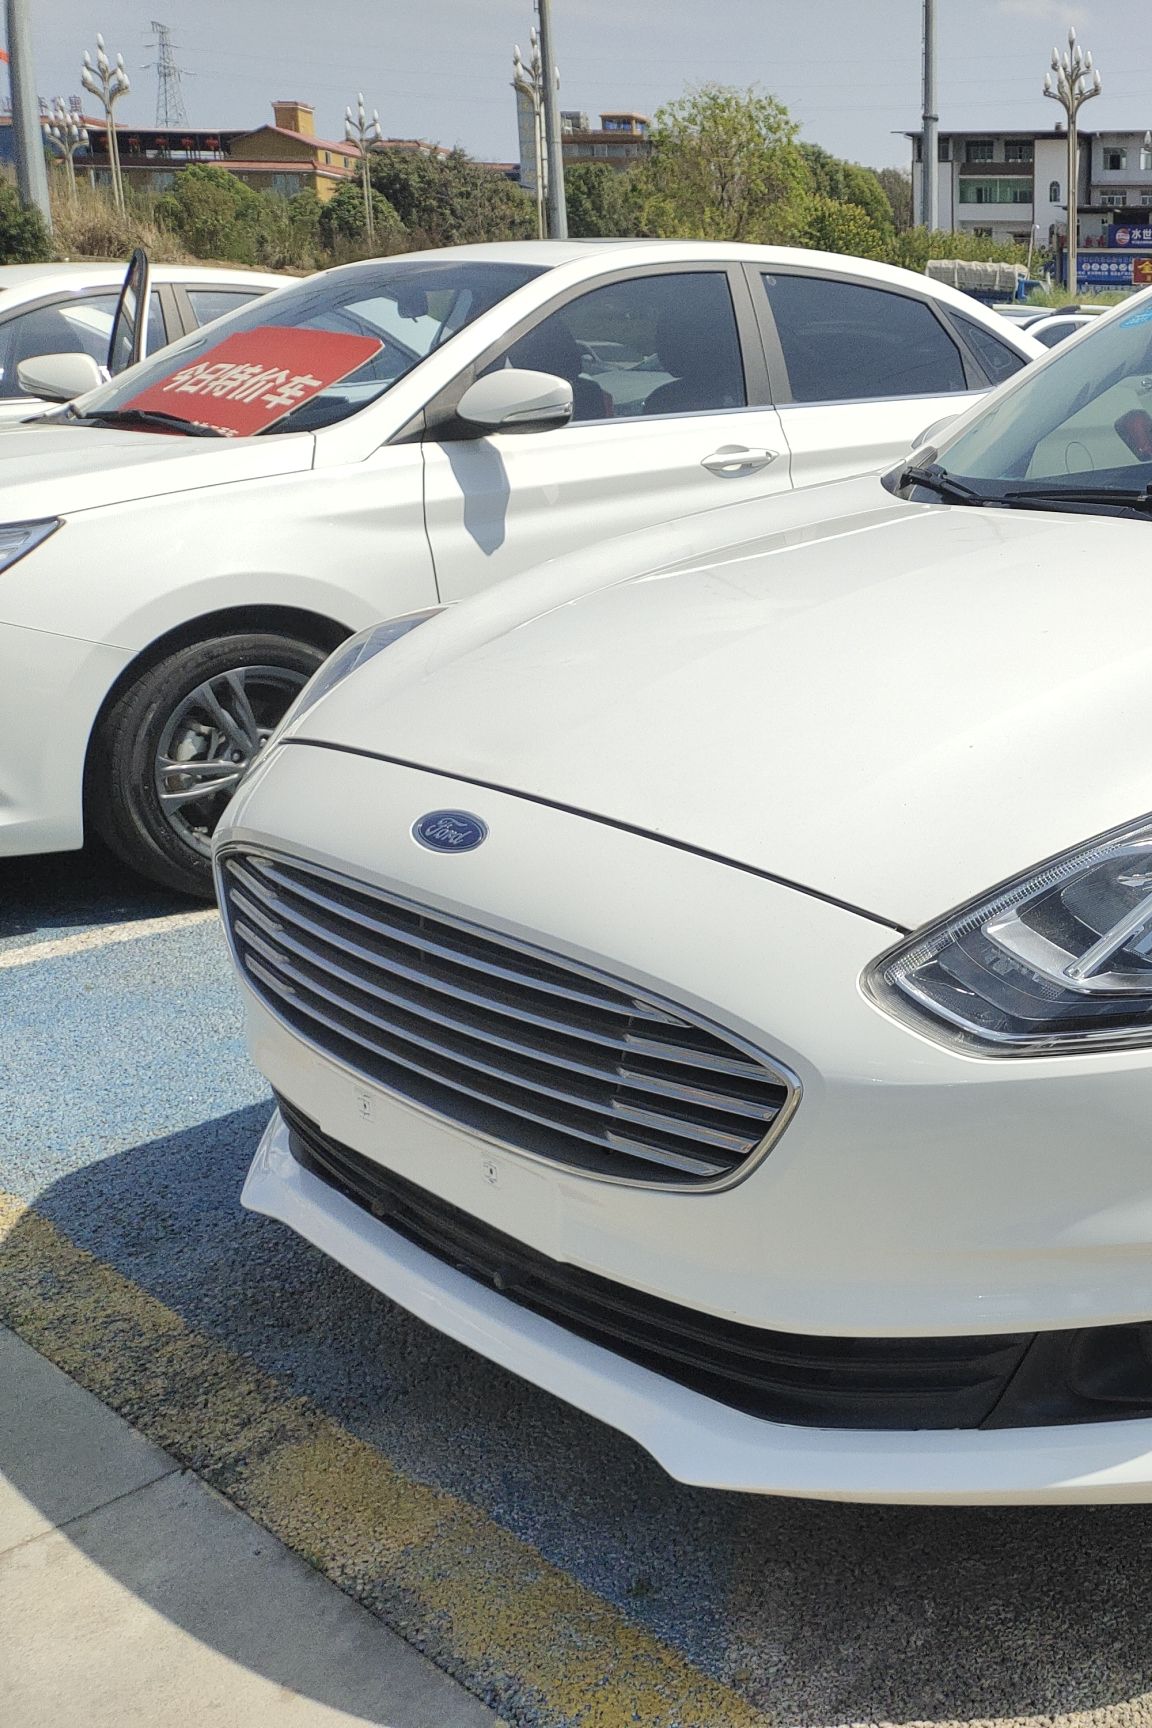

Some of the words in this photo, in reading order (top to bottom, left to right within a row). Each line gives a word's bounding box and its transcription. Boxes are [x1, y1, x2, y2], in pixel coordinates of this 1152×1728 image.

[162, 361, 322, 410] 今日特价车
[425, 817, 473, 845] Ford
